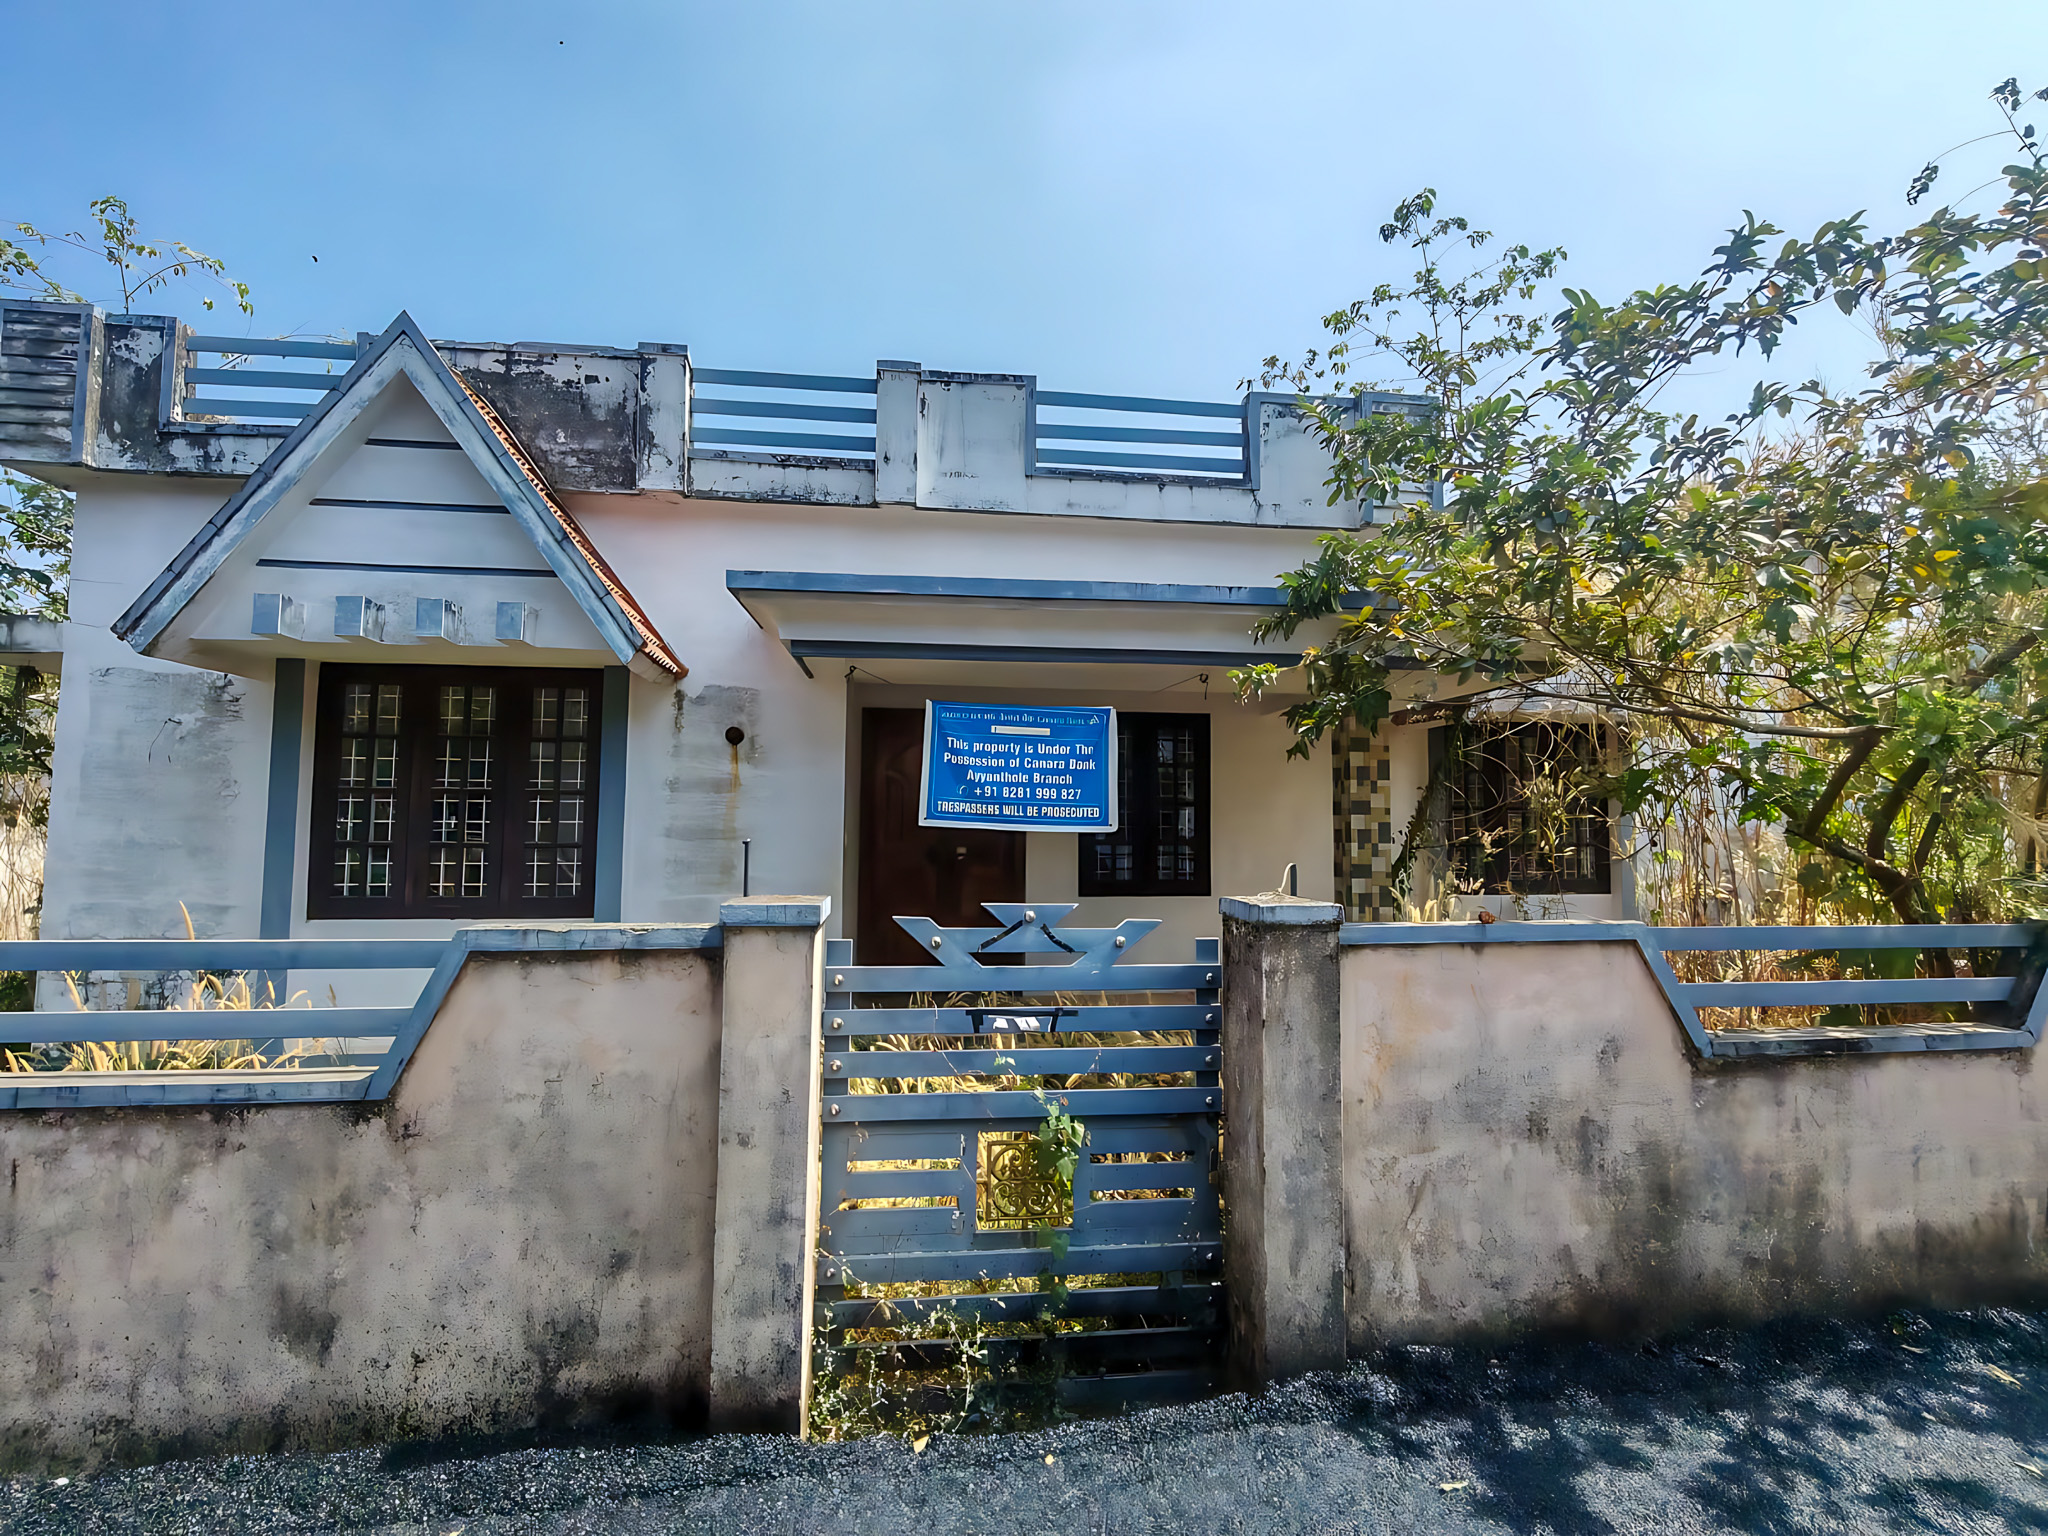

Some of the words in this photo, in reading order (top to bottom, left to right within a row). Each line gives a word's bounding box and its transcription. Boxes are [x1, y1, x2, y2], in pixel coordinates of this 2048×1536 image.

[947, 737, 968, 750] This
[973, 742, 1020, 756] property
[1024, 742, 1033, 754] is
[1038, 743, 1070, 755] Under
[1075, 744, 1094, 755] The
[944, 752, 1005, 767] Possession
[1009, 758, 1020, 768] of
[1024, 757, 1065, 769] Canara
[1069, 759, 1096, 770] Bank
[966, 769, 1029, 783] Ayyanthole
[1033, 772, 1073, 785] Branch
[974, 785, 997, 797] +91
[1002, 786, 1030, 798] 8281
[1035, 787, 1057, 799] 999
[1061, 788, 1081, 800] 827
[937, 801, 999, 815] TRESPASSERS
[1002, 805, 1024, 816] WILL
[1027, 806, 1039, 817] BE
[1041, 806, 1100, 818] PROSECUTED
